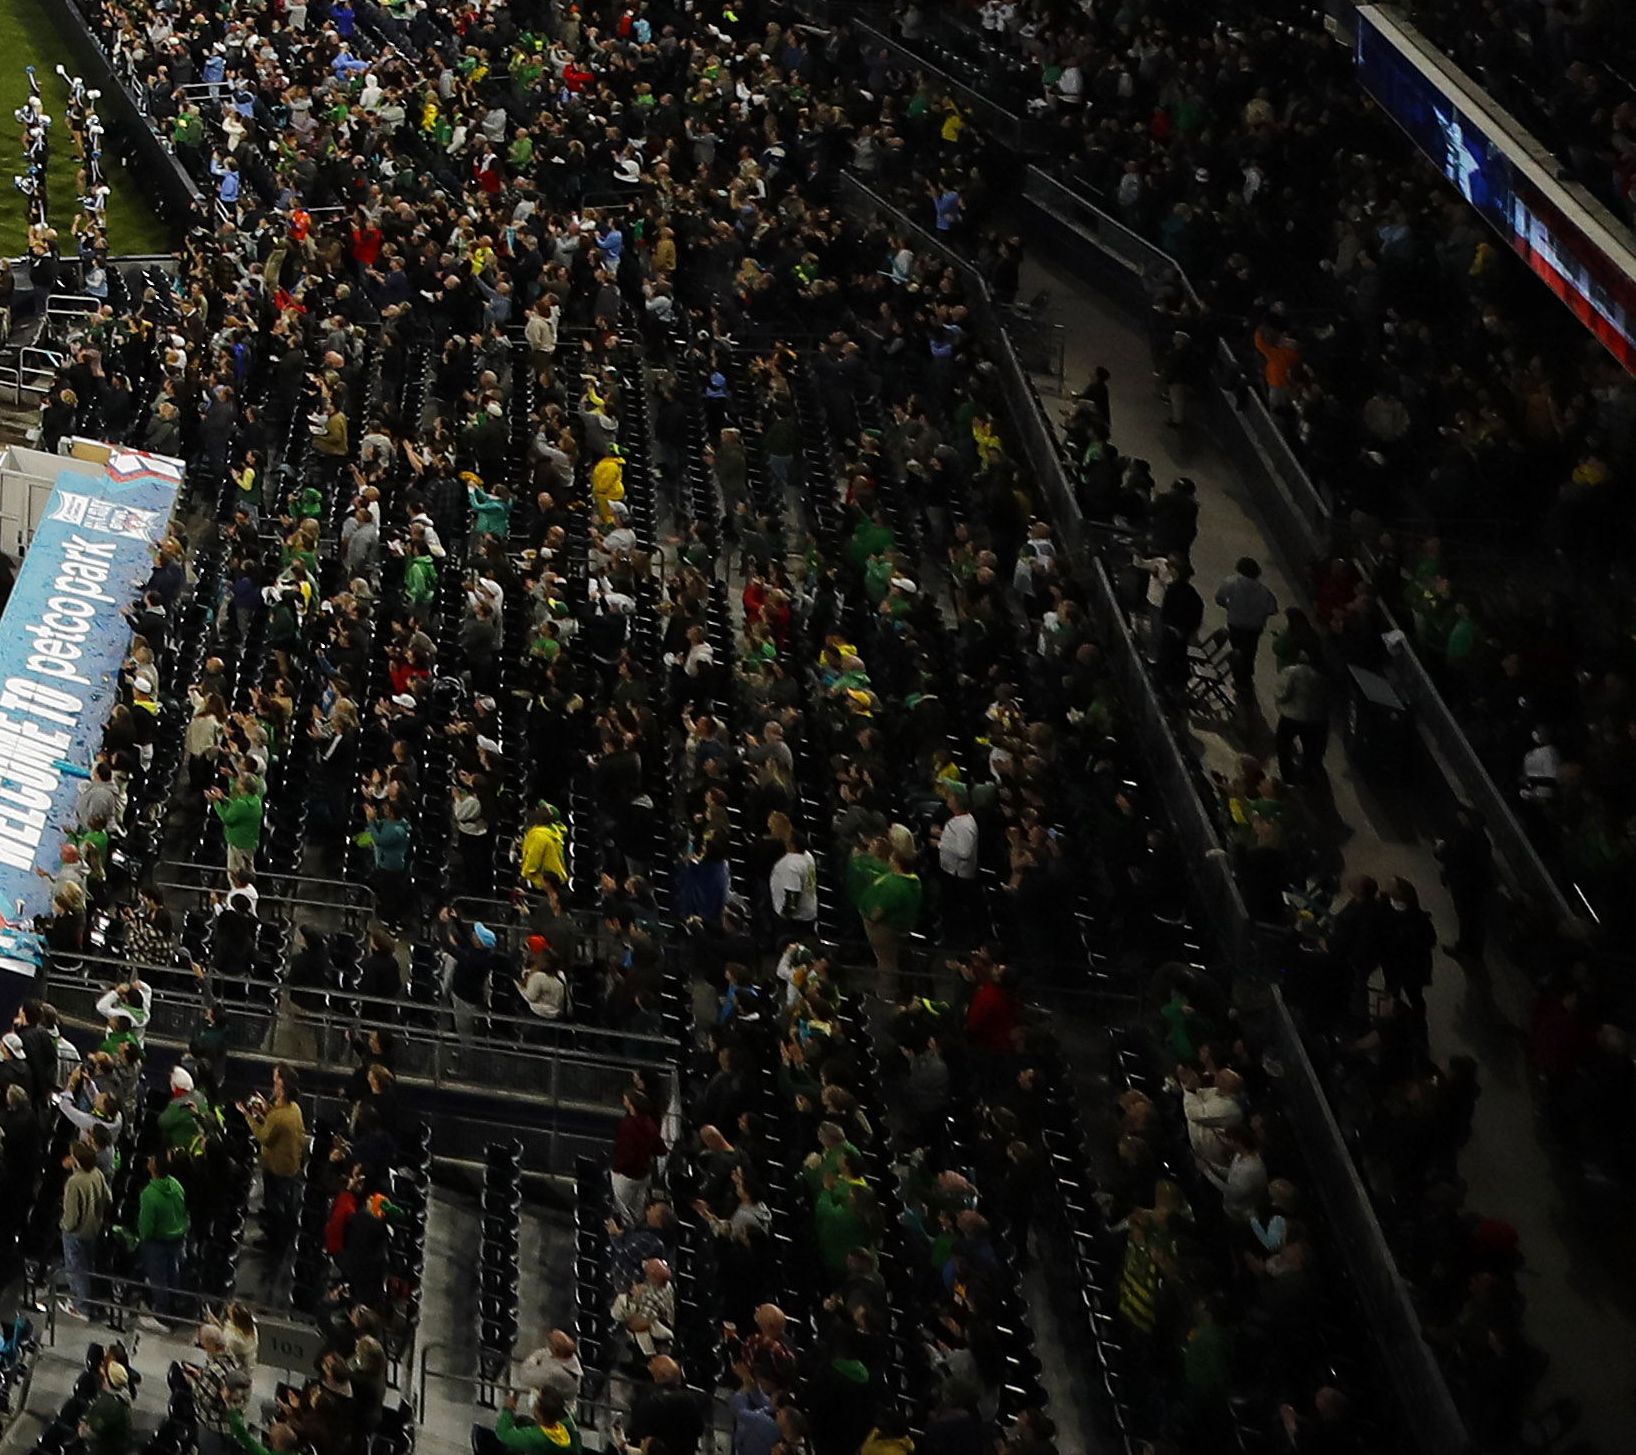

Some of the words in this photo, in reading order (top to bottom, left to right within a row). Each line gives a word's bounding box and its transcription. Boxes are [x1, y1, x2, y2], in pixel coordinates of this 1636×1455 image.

[52, 533, 118, 617] park
[26, 596, 98, 689] petco
[7, 676, 84, 732] TO
[271, 1336, 305, 1359] 103
